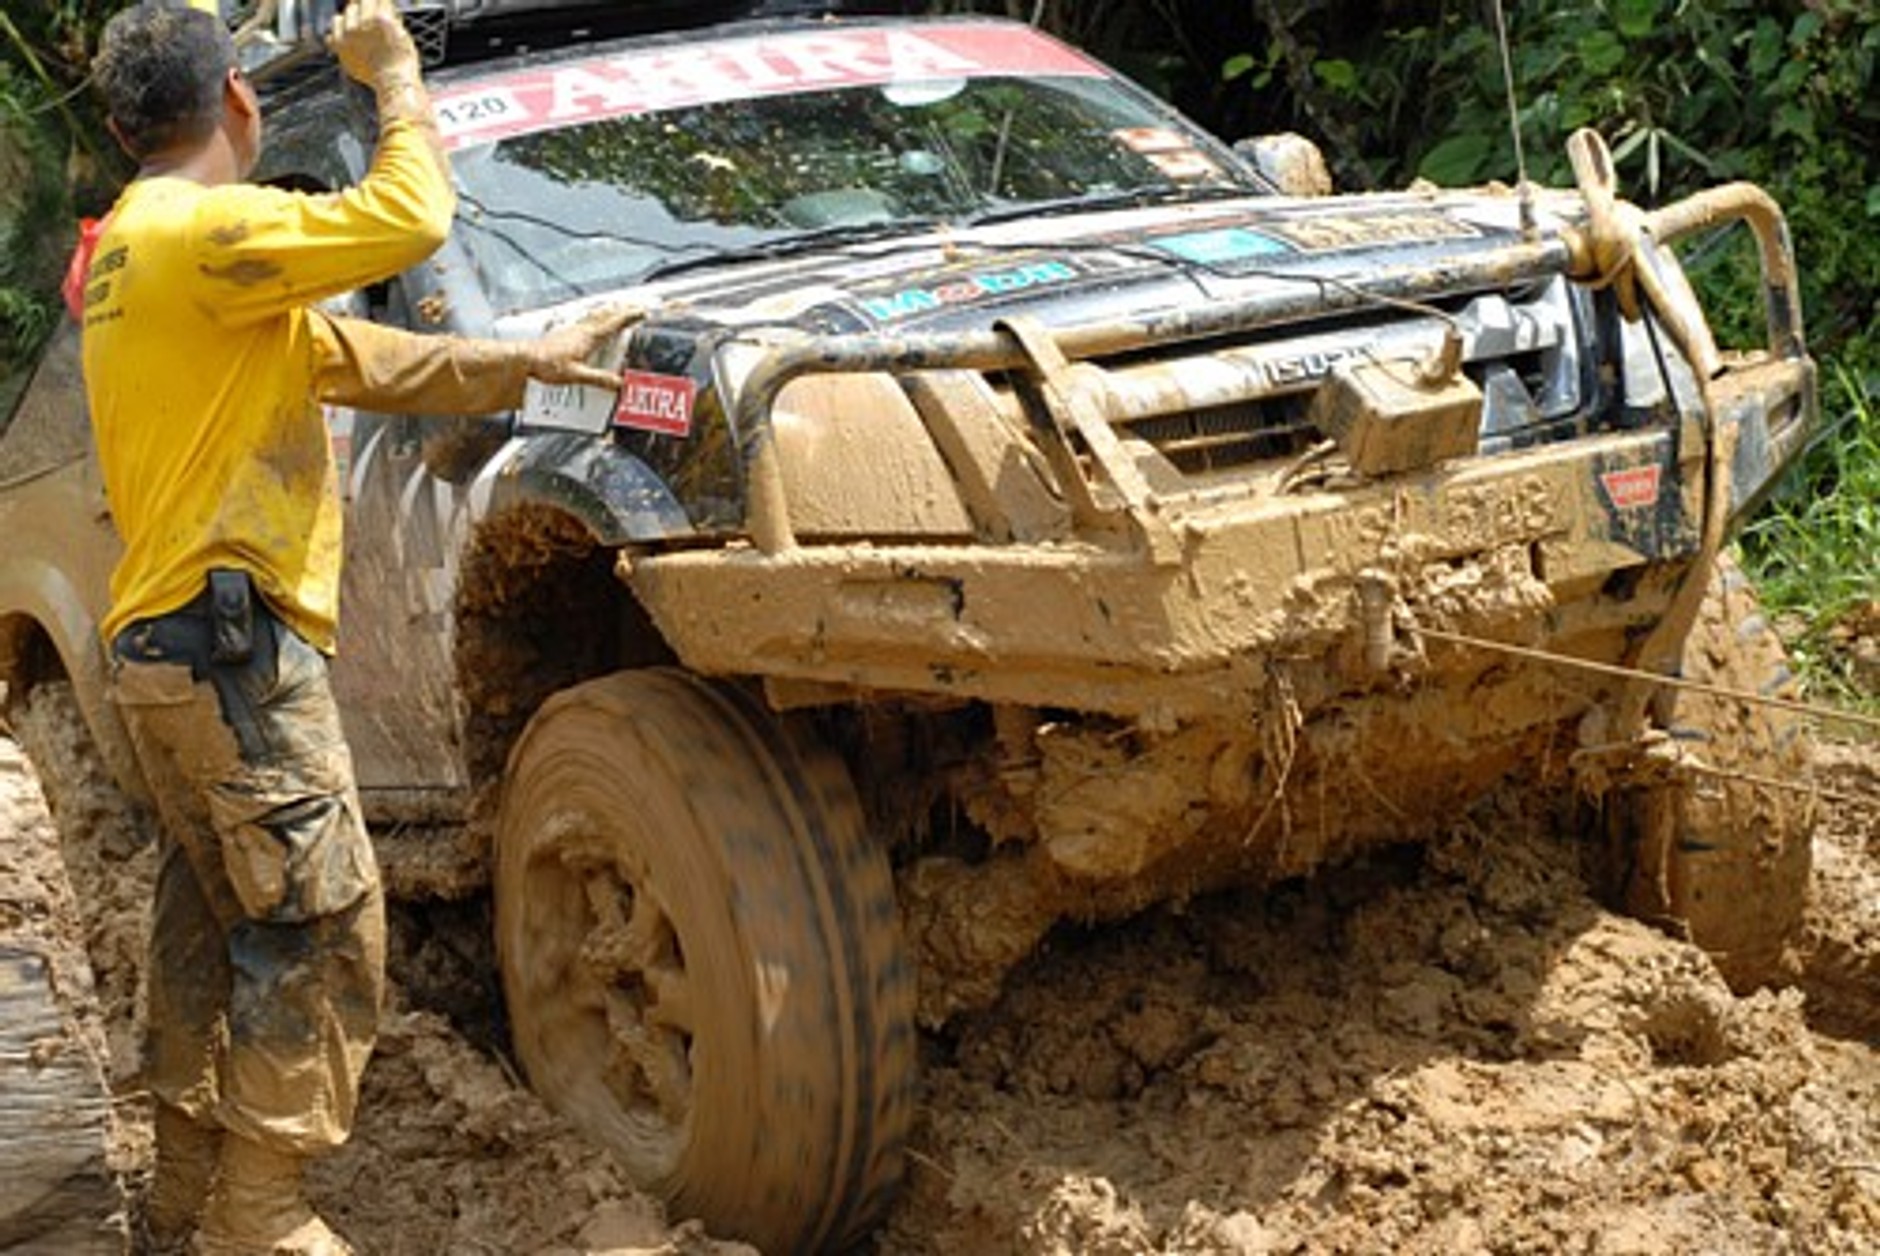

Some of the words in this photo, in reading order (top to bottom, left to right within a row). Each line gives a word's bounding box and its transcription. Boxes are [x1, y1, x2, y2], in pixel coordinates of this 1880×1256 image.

[547, 27, 986, 118] AKIRA
[439, 97, 508, 123] 120
[860, 260, 1080, 321] Mobil
[619, 382, 688, 422] AKIRA
